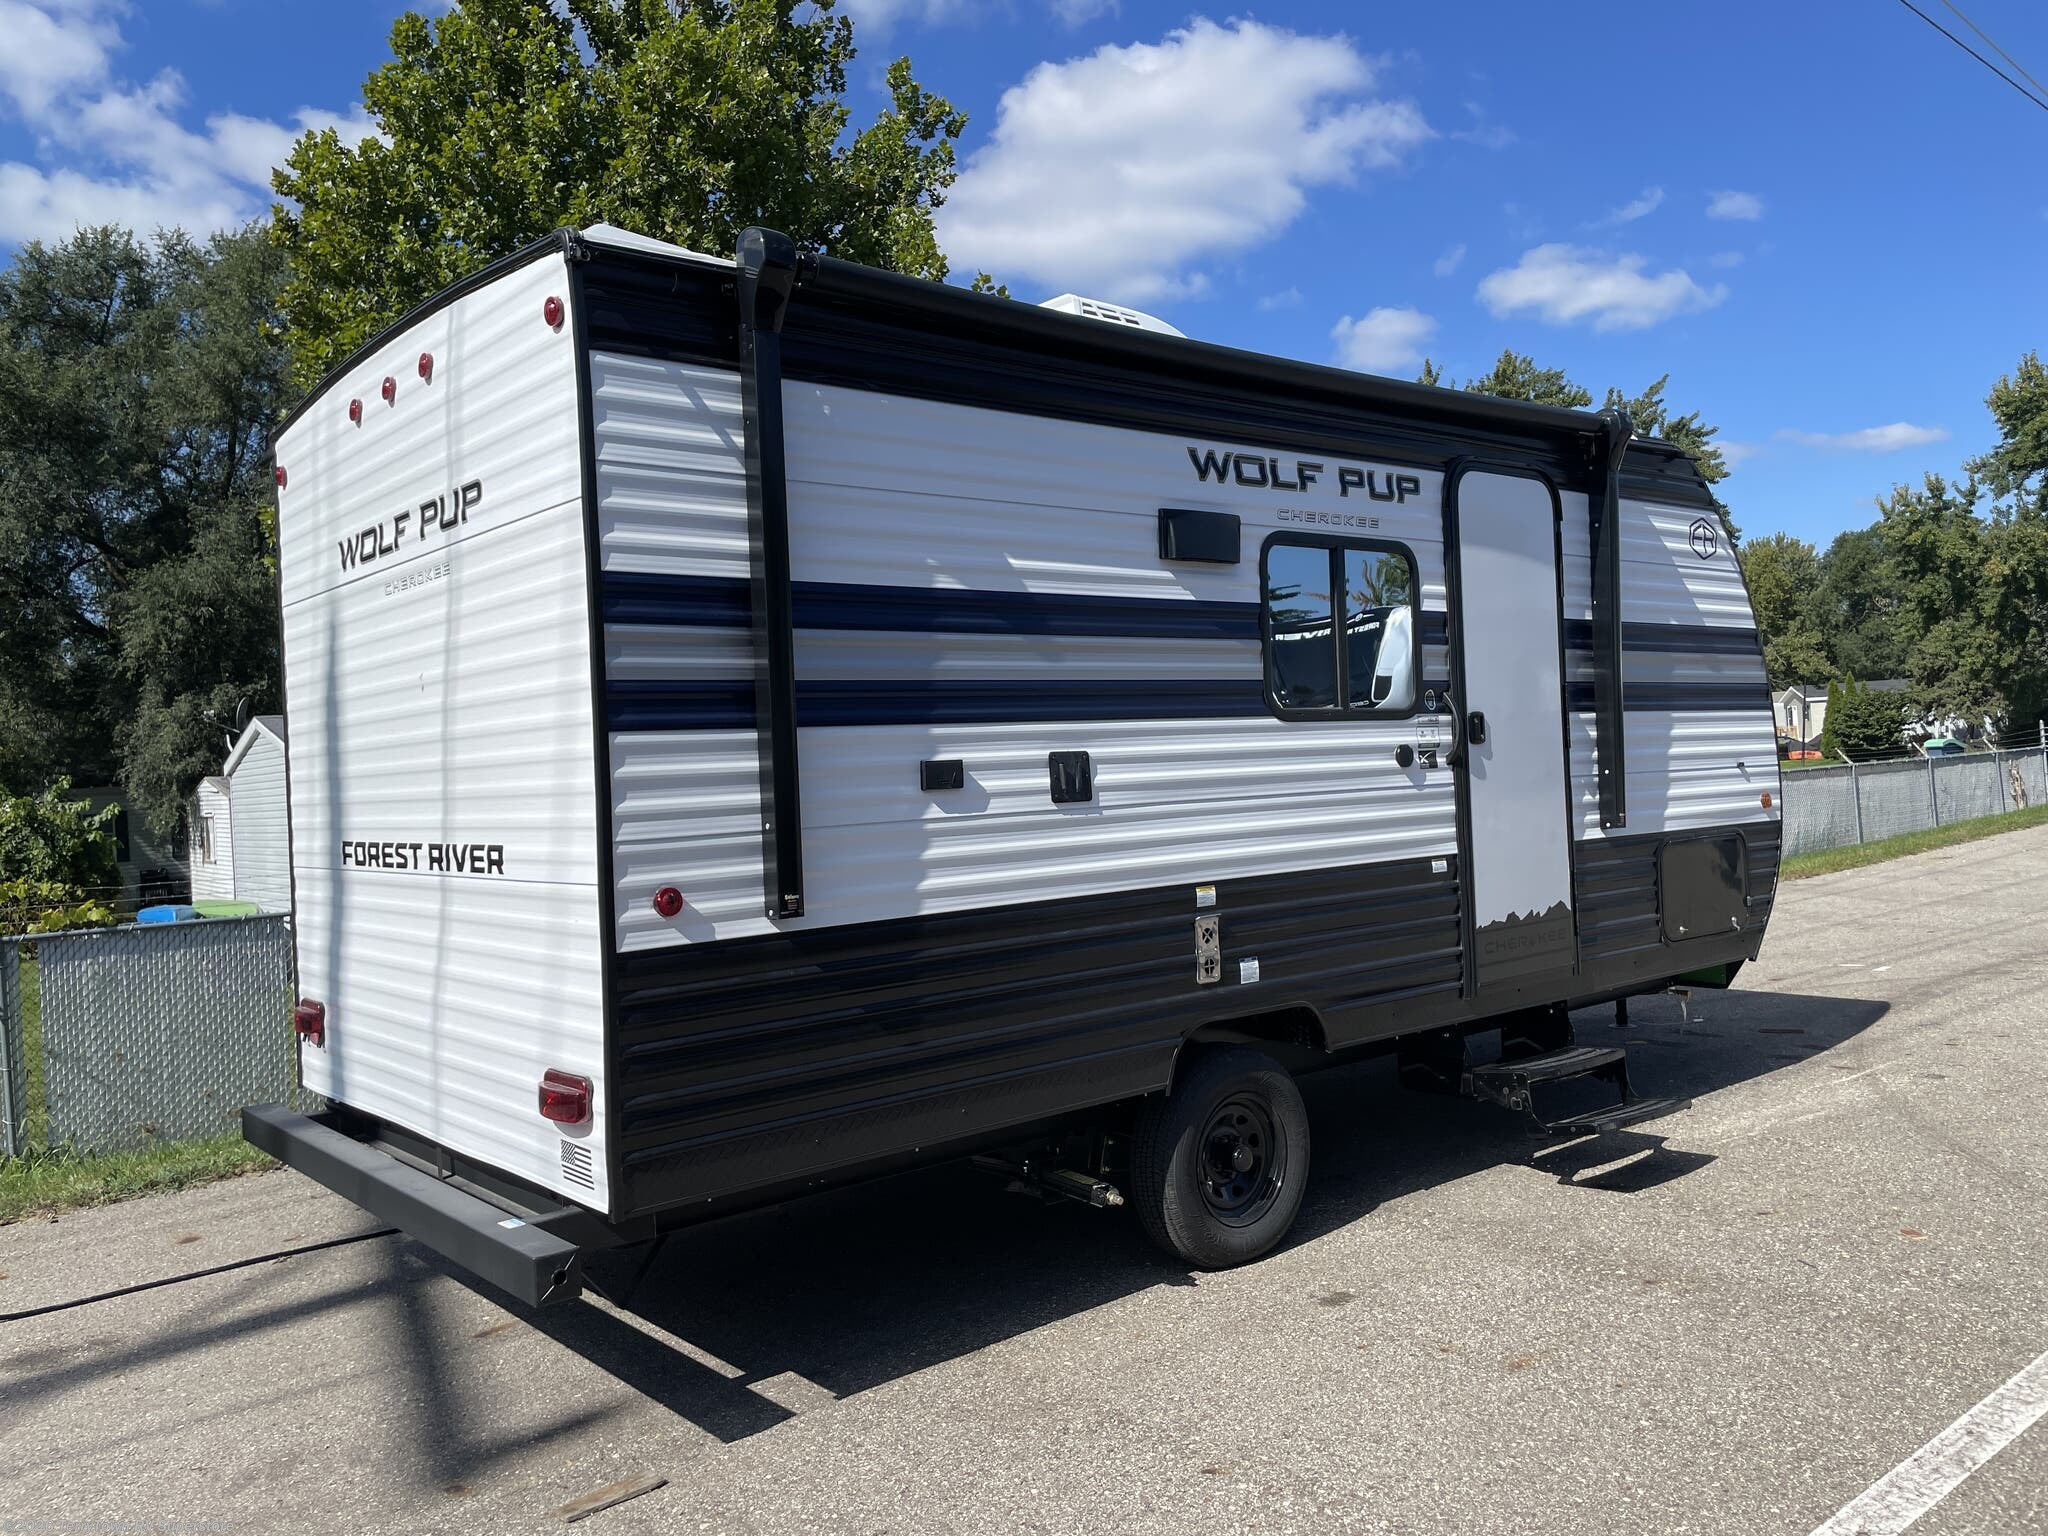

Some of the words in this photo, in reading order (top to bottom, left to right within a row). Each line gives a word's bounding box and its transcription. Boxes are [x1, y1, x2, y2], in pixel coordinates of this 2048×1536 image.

[1187, 447, 1324, 493] WOLF
[1338, 466, 1420, 504] PUP
[338, 510, 411, 572] WOLF
[419, 478, 482, 541] PUP
[1277, 509, 1380, 529] CHEROKEE
[384, 561, 451, 596] CHEROKEE
[342, 841, 423, 870] FOREST
[428, 843, 504, 875] RIVER
